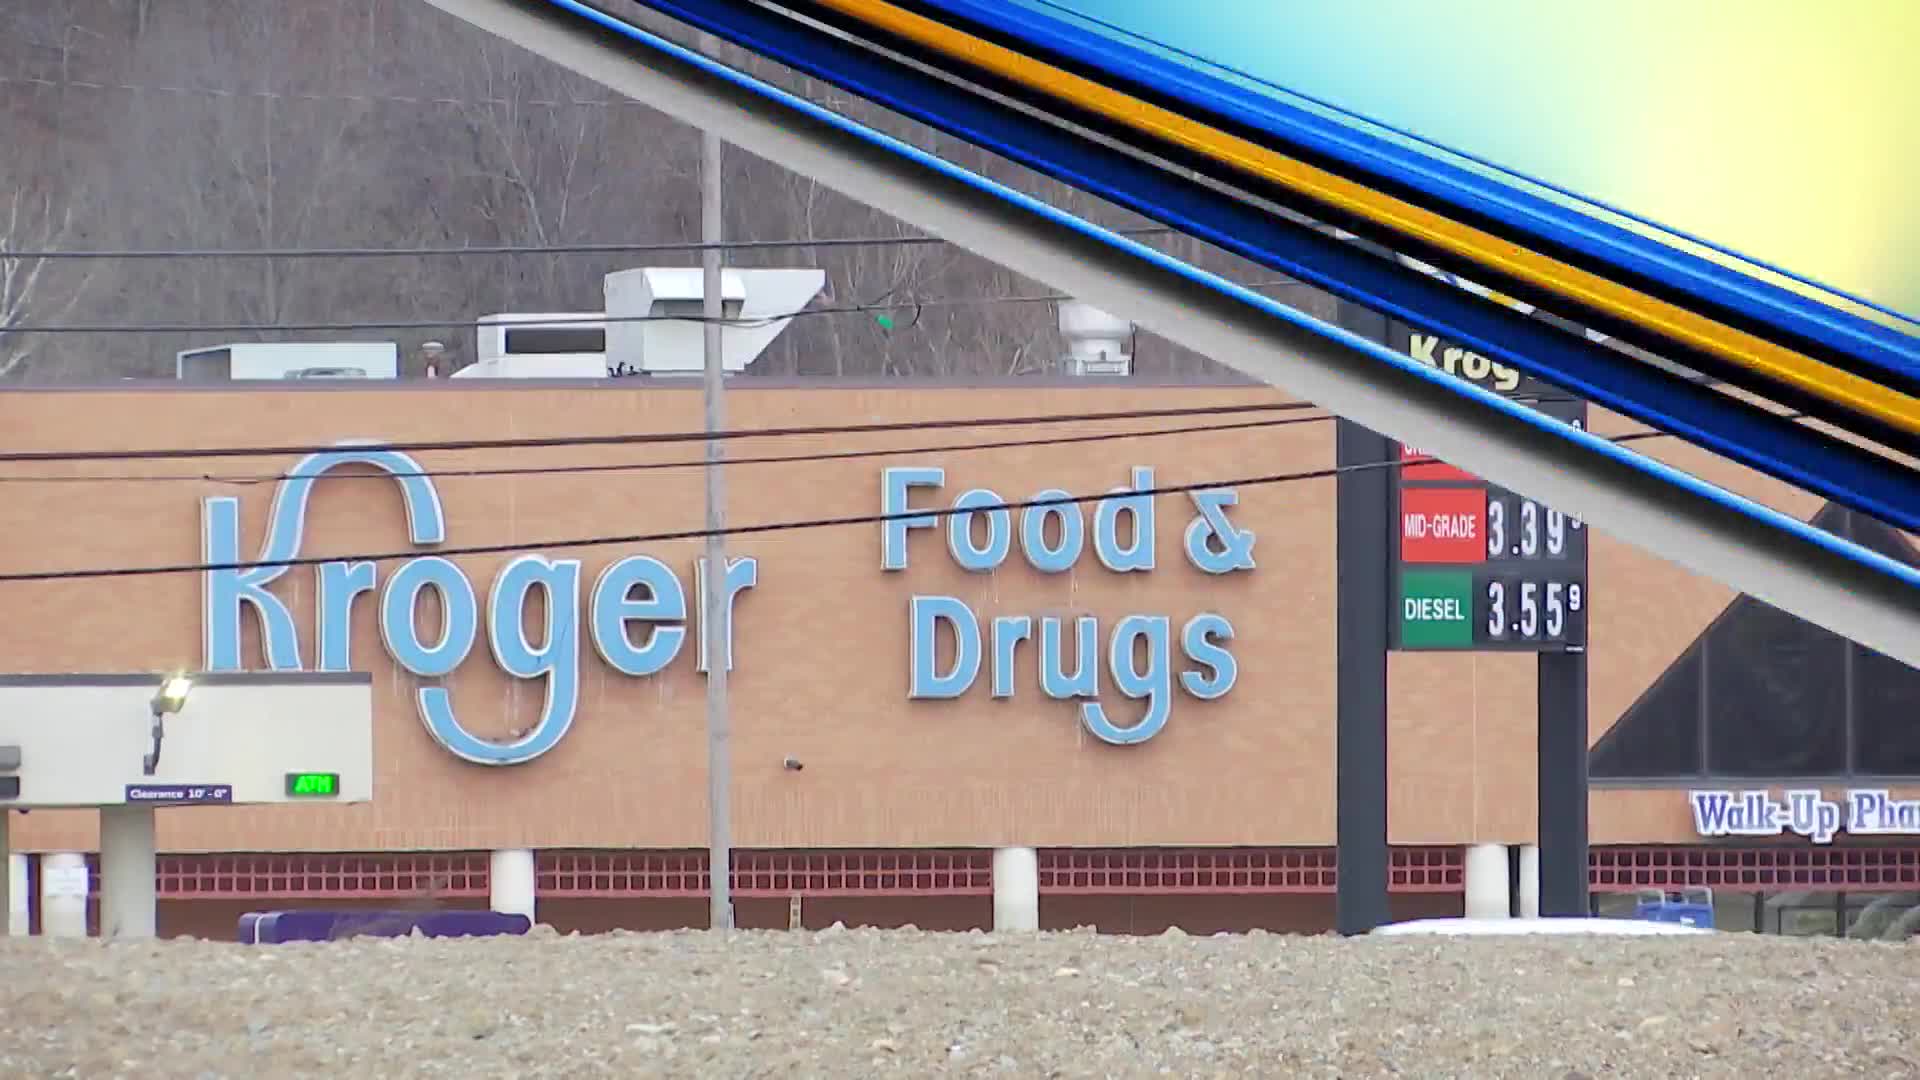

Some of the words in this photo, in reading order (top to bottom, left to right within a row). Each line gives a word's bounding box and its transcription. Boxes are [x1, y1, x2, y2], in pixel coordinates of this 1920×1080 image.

[1410, 335, 1521, 391] Krog
[881, 466, 1155, 572] Food
[1185, 488, 1256, 574] &
[1404, 513, 1476, 539] MID-GRADE
[200, 442, 757, 766] Kroger
[1404, 598, 1465, 620] DIESEL
[909, 595, 1238, 745] Drugs
[130, 788, 184, 799] Clearance
[294, 774, 332, 794] ATM
[1692, 791, 1838, 842] Walk-Up
[1850, 791, 1920, 832] Pha
